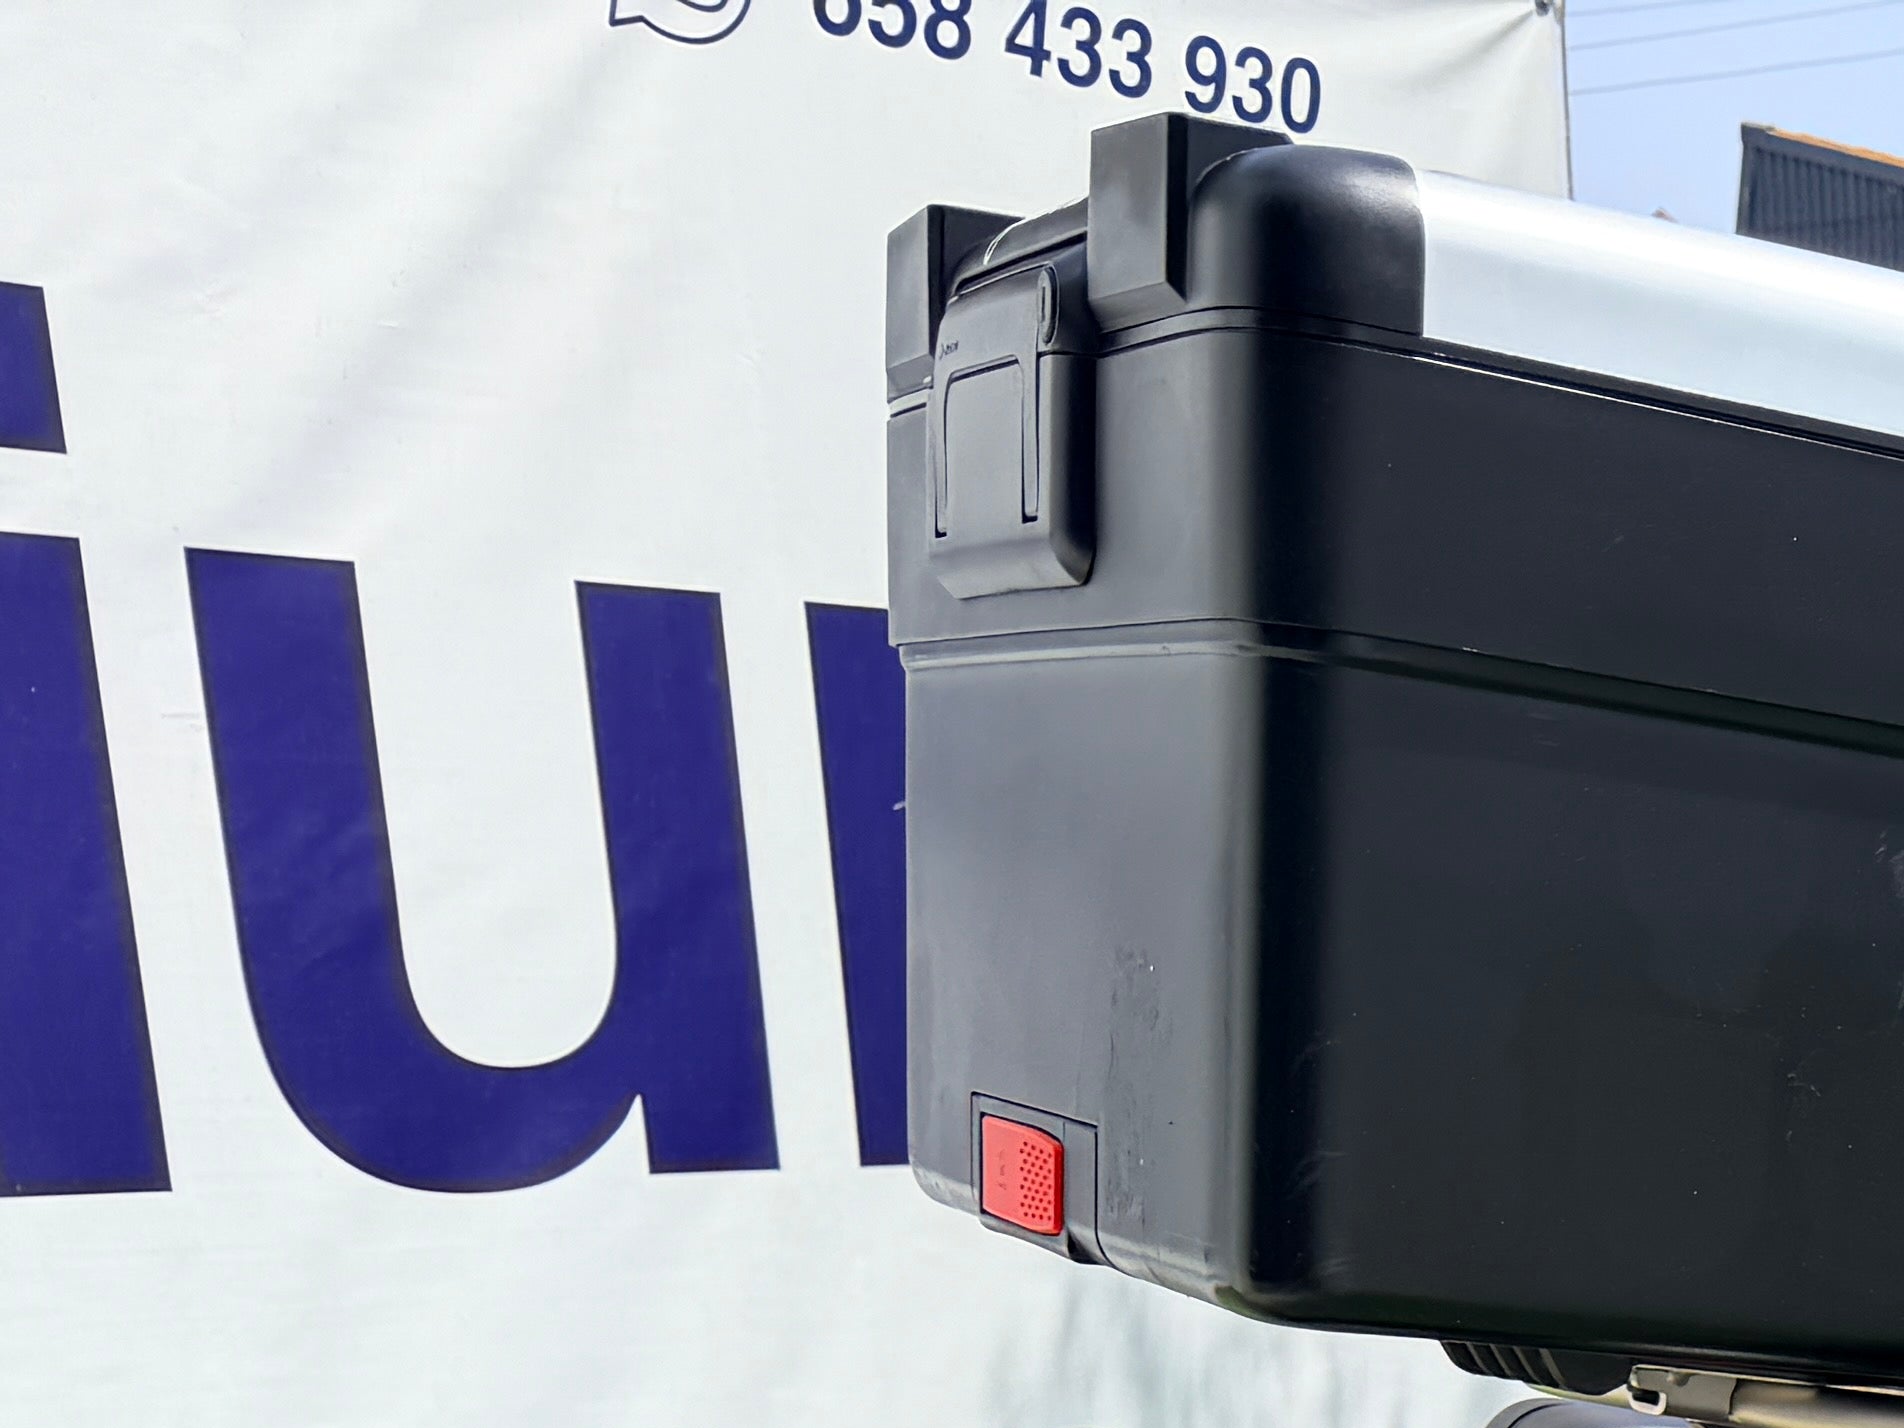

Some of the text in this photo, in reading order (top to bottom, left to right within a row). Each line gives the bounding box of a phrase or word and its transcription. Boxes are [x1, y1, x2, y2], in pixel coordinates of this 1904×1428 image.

[1004, 0, 1153, 98] 433
[1185, 35, 1321, 133] 930
[0, 281, 914, 1195] iu
